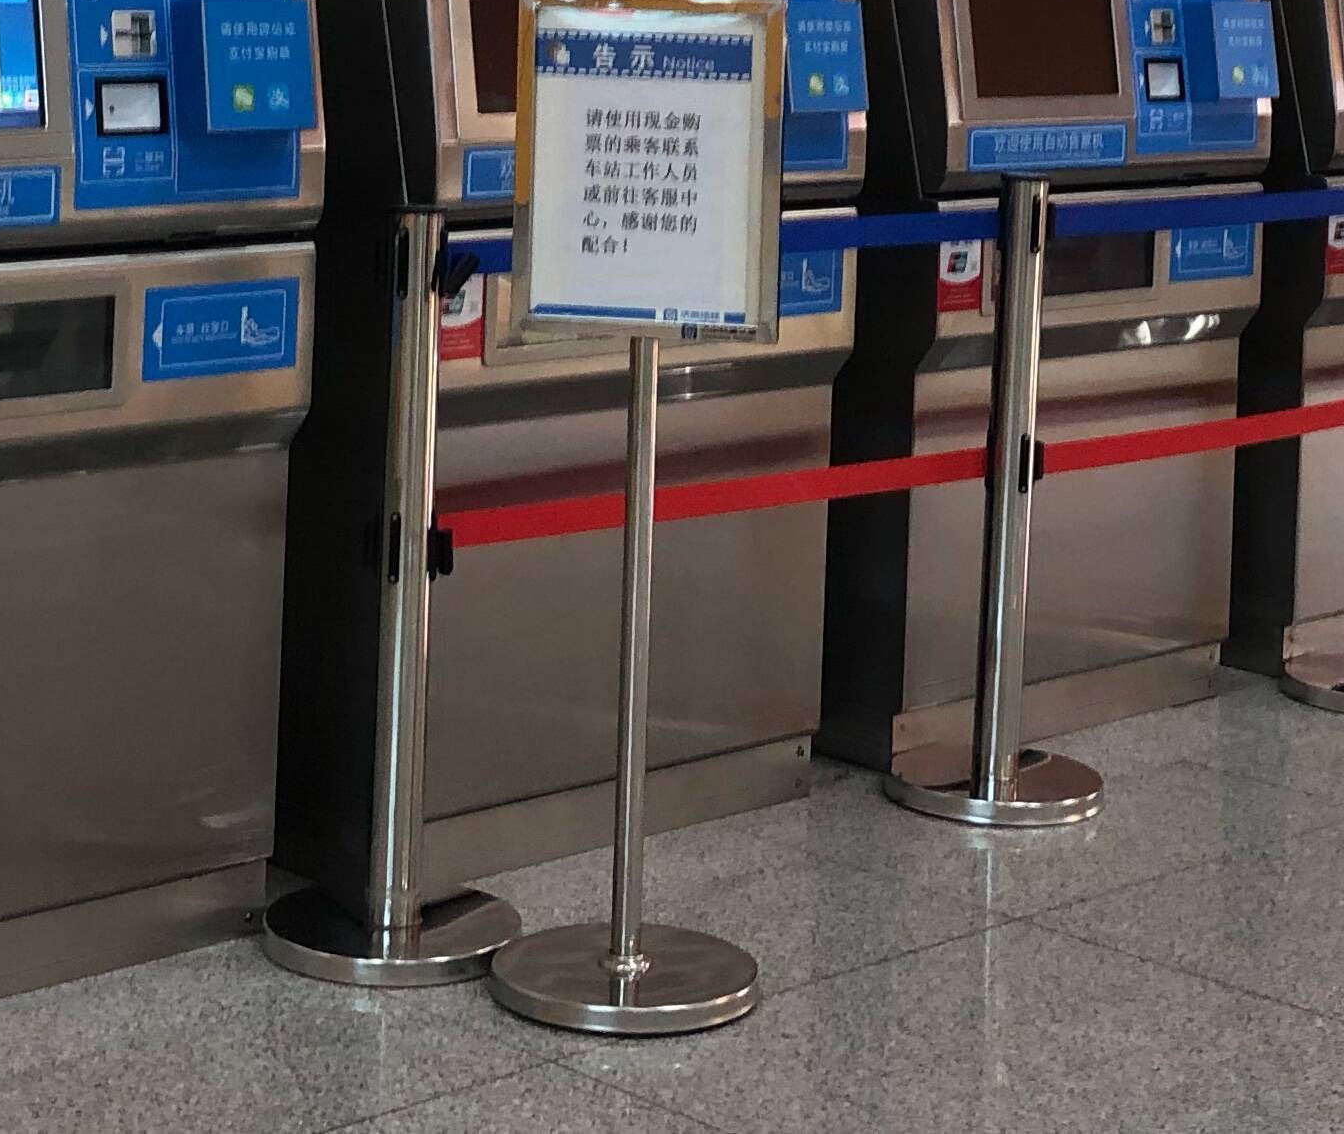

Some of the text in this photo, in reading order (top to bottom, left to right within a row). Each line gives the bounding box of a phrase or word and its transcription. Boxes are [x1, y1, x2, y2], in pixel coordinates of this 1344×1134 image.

[593, 42, 655, 72] 告示
[662, 54, 716, 71] Notice
[585, 108, 702, 131] 请使用现金购
[584, 133, 700, 157] 票的乘客联系
[584, 159, 699, 182] 车站工作人员
[582, 184, 699, 208] 或前往客服中
